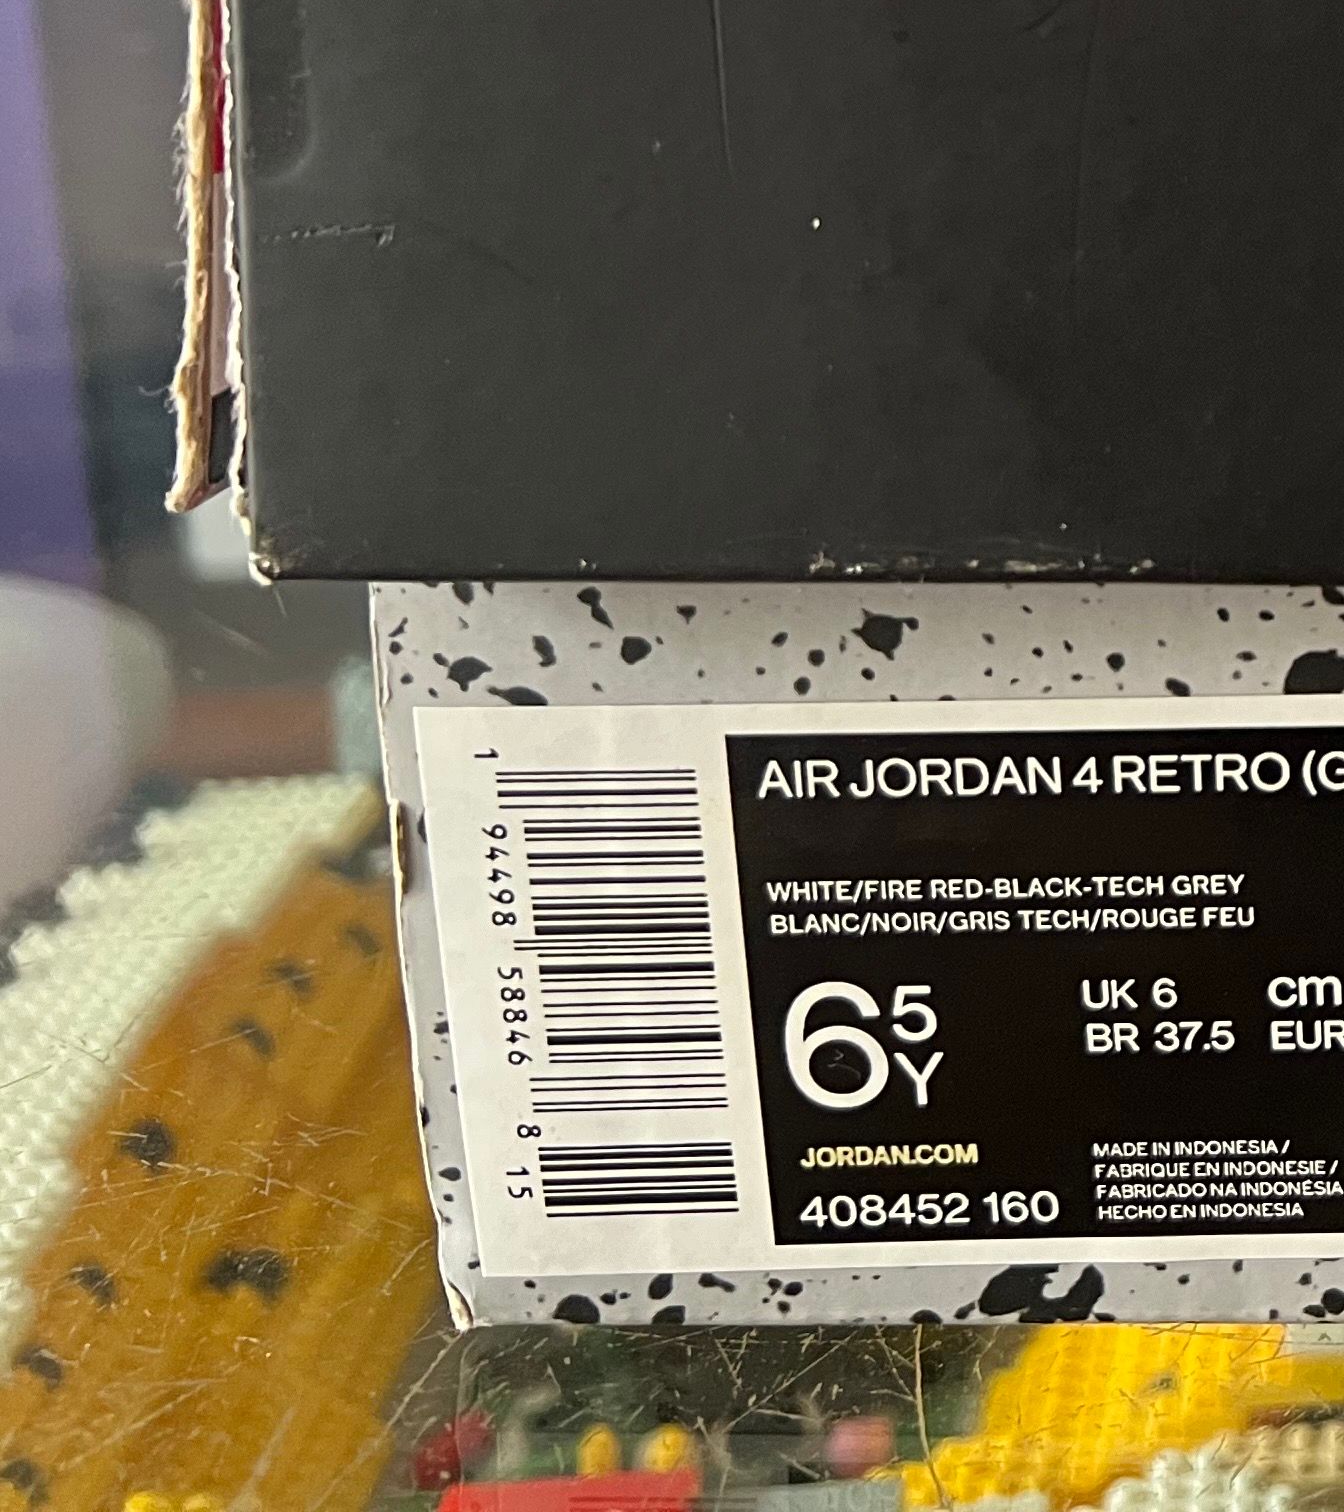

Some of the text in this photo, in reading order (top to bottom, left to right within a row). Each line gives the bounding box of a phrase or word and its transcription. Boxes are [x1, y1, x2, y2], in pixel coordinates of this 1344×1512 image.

[758, 759, 841, 800] AIR
[848, 756, 1062, 799] JORDAN
[1072, 756, 1104, 794] 4
[1112, 751, 1291, 794] RETRO
[481, 823, 518, 926] 94498
[766, 873, 1245, 904] WHITE/FIRE RED-BLACK-TECH GREY
[770, 906, 1255, 936] BLANC/NOIR/GRIS TECH/ROUGE FEU
[1081, 977, 1178, 1010] UK 6
[1267, 975, 1343, 1008] cm
[497, 966, 533, 1065] 58846
[1085, 1020, 1236, 1053] BR 37.5
[800, 1143, 979, 1169] JORDAN.COM
[1093, 1141, 1149, 1157] MADE
[1152, 1141, 1171, 1156] IN
[1174, 1139, 1279, 1156] INDONESIA
[1094, 1162, 1191, 1178] FABRIQUE
[1193, 1161, 1220, 1176] EN
[1096, 1182, 1208, 1199] FABRICADO
[1210, 1182, 1238, 1197] NA
[799, 1190, 1060, 1228] 408452 160
[1098, 1202, 1305, 1220] HECHO EN INDONESIA
